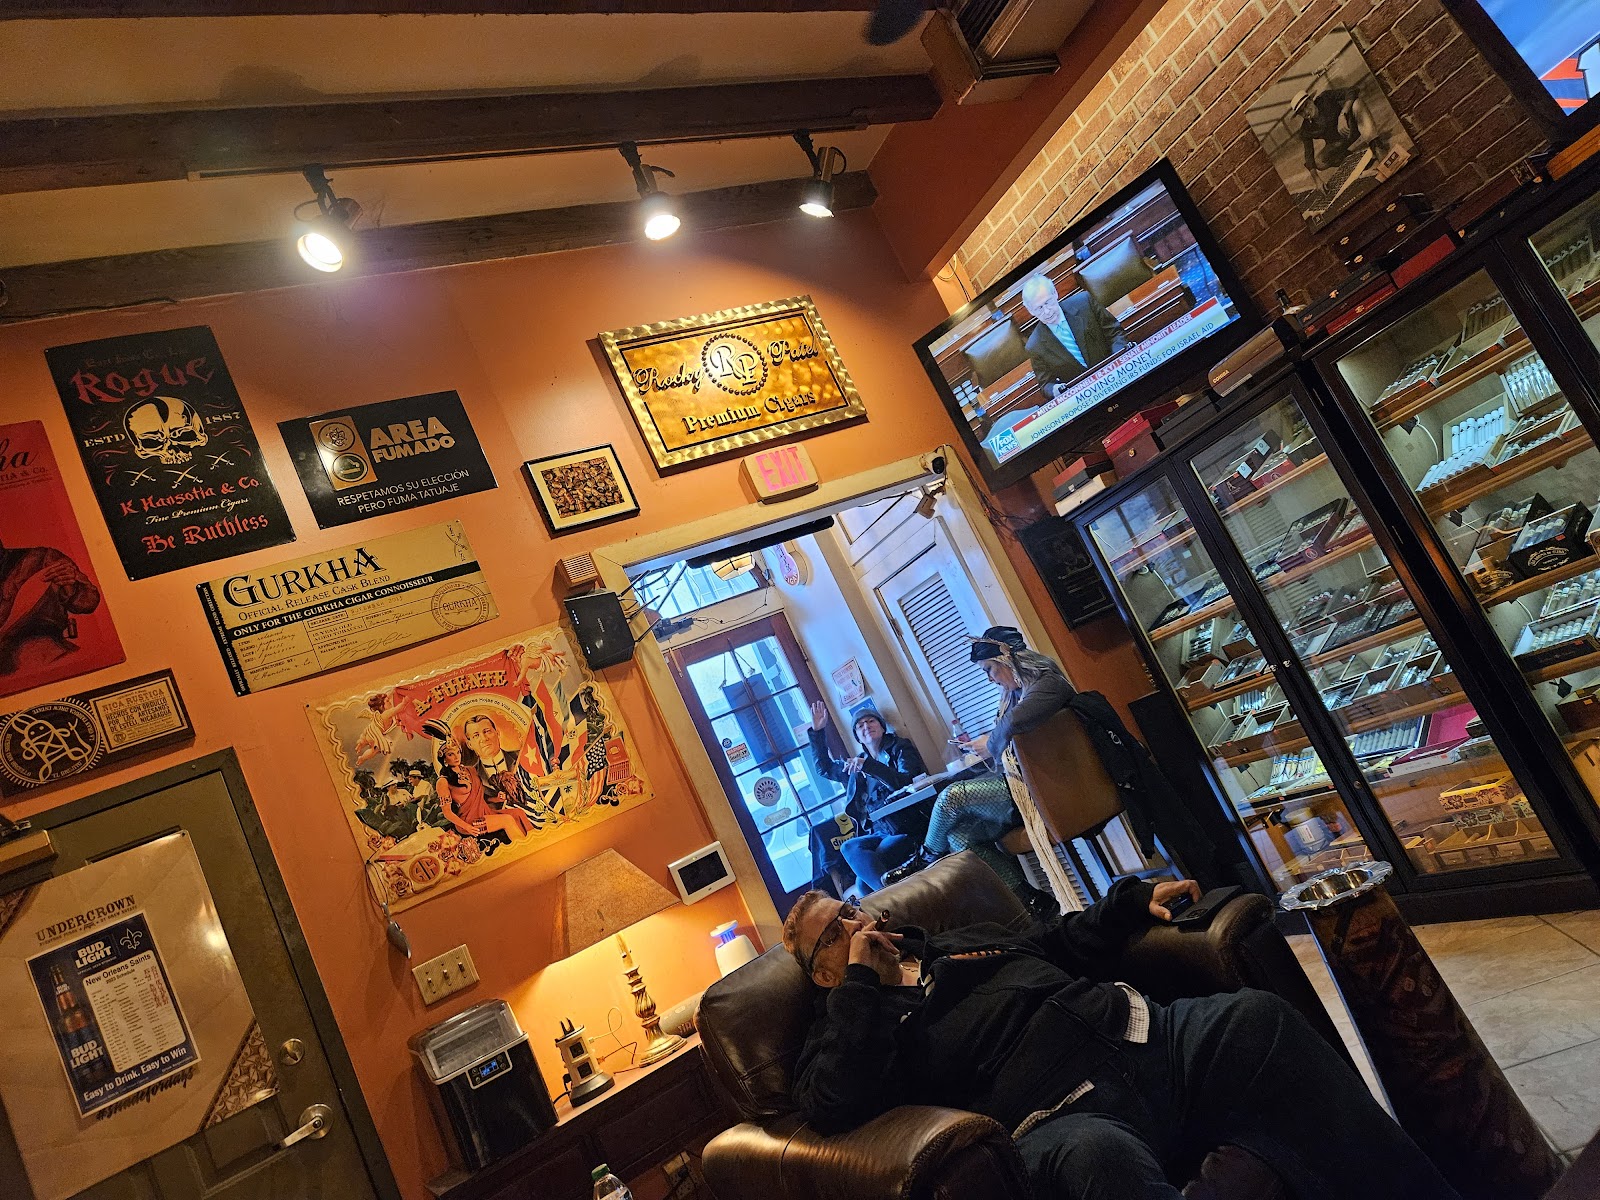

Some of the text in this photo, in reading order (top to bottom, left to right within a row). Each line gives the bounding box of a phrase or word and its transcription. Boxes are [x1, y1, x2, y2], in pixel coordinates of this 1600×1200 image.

[71, 355, 216, 405] Rogue
[632, 335, 820, 396] Rocky Patel
[1030, 320, 1214, 441] JOHNSON PROPOSES DIVERTING IRS FUNDS FOR ISRAEL AID
[1037, 400, 1058, 417] MITCH
[1056, 375, 1096, 402] MCCONNELL
[1119, 346, 1142, 363] SENATE
[1140, 327, 1171, 350] MINORITY
[1169, 314, 1193, 331] LEADER
[1073, 349, 1154, 403] MOVING MONEY
[1211, 368, 1231, 383] COHIBA
[83, 411, 241, 448] ESTD 1887
[682, 390, 817, 436] Premium Cigars
[370, 416, 450, 449] AREA
[371, 434, 457, 463] FUMADO
[997, 438, 1017, 456] NEWS
[998, 432, 1014, 447] FOX
[756, 446, 808, 491] EXIT
[119, 499, 138, 515] K
[217, 479, 235, 494] &
[236, 473, 262, 489] Co.
[336, 467, 470, 506] RESPETAMOS SU ELECCIÓN
[356, 482, 460, 513] PERO FUMA TATUAJE
[143, 493, 251, 524] Fine Premium Cigars
[140, 509, 270, 555] Be Ruthless
[222, 547, 389, 608] GURKHA
[232, 574, 435, 638] ONLY FOR THE GURKHA CIGAR CONNOISSEUR
[236, 571, 391, 621] OFFICIAL RELEASE CASK BLEND
[442, 595, 477, 614] GURKHA
[101, 699, 123, 711] NICA
[124, 687, 164, 704] RUSTICA
[105, 697, 167, 721] HECHOS CON ORGULLO
[107, 718, 120, 726] POR
[137, 703, 169, 717] ARTESANOS
[139, 708, 171, 723] NICARAGUA
[36, 895, 135, 942] UNDERCROWN
[74, 945, 113, 968] LIGHT
[76, 939, 105, 958] BUD
[85, 952, 151, 986] New Orleans Saints
[70, 1039, 98, 1058] BUD
[70, 1046, 105, 1069] LIGHT
[82, 1084, 104, 1102] Easy
[104, 1079, 115, 1091] to
[114, 1067, 140, 1086] Drink.
[139, 1057, 162, 1075] Easy
[160, 1053, 171, 1064] to
[170, 1045, 186, 1059] Win
